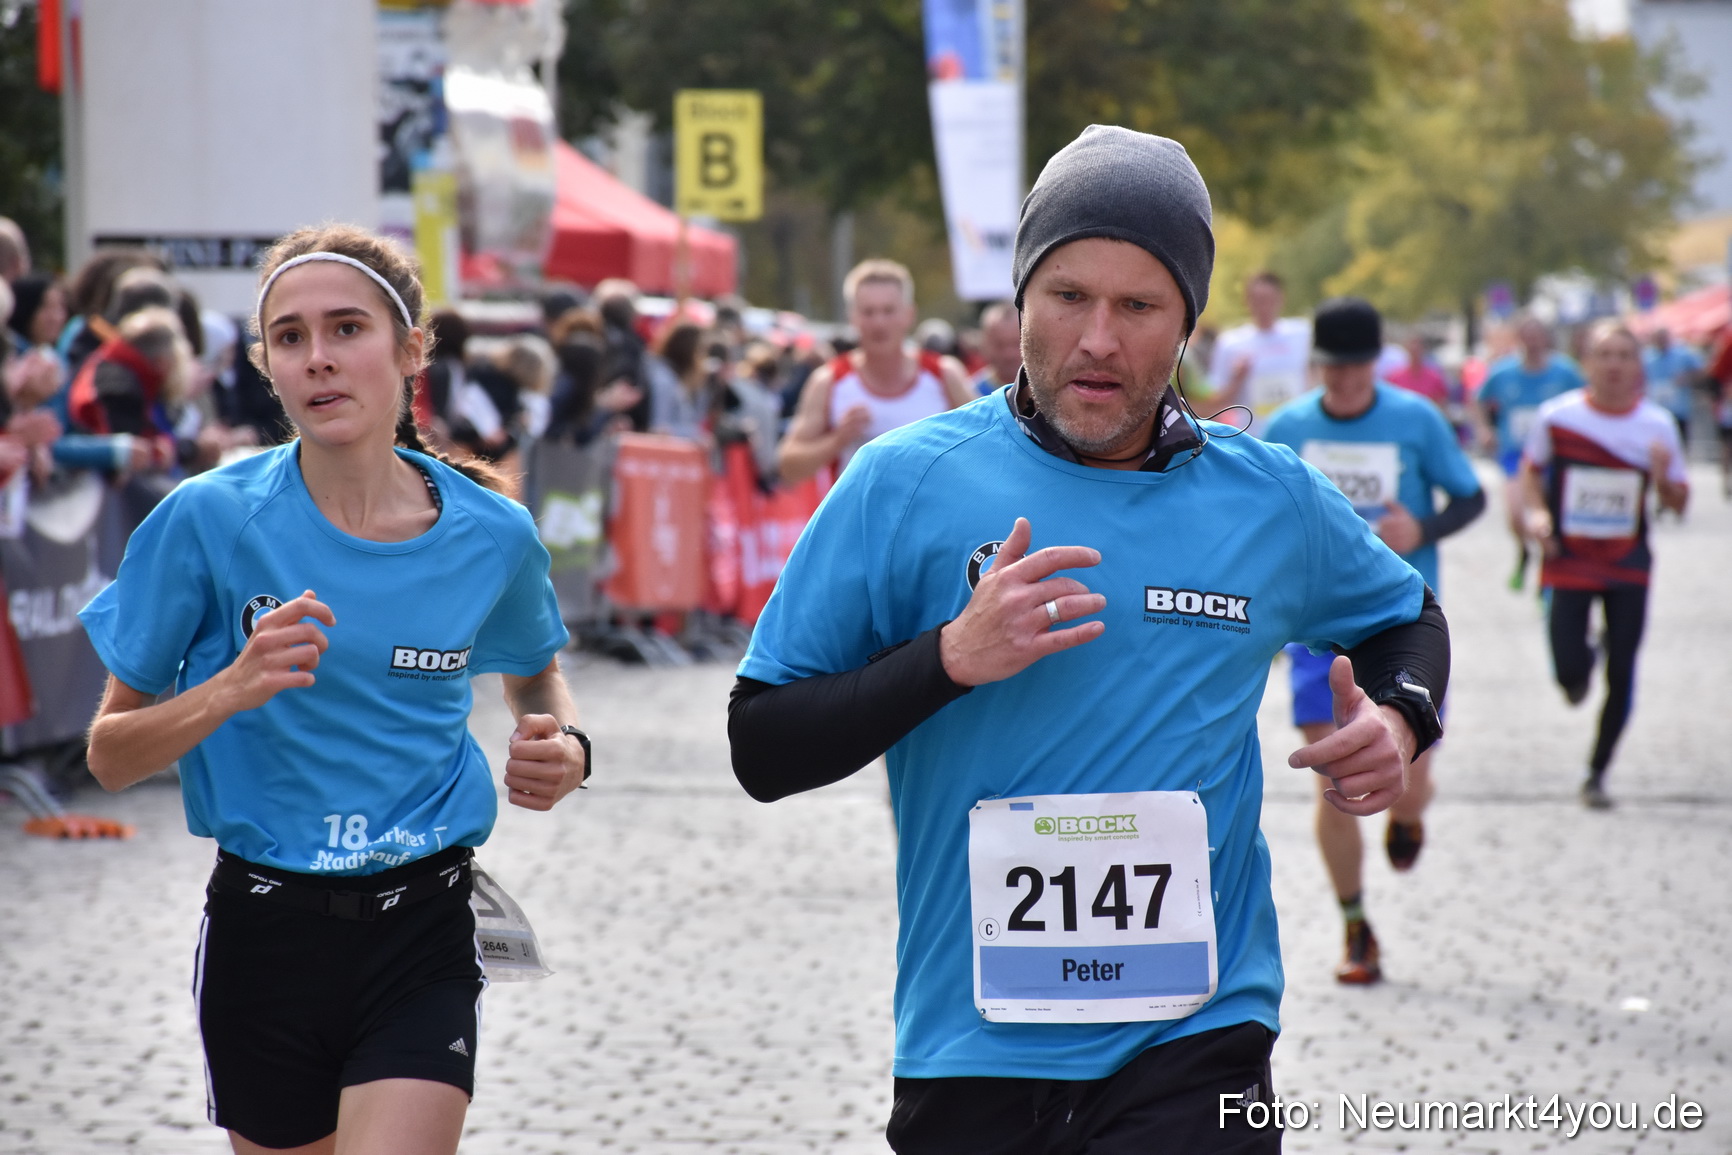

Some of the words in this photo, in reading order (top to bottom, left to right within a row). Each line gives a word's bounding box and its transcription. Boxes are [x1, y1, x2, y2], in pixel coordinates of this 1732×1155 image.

[700, 131, 740, 189] B
[1145, 586, 1251, 624] BOCK
[1143, 614, 1180, 625] inspired
[1182, 616, 1194, 628] by
[1196, 620, 1220, 630] smart
[1221, 623, 1251, 635] concepts
[391, 646, 472, 672] BOCK
[387, 670, 420, 680] inspired
[421, 672, 431, 682] by
[432, 673, 450, 682] smart
[1057, 814, 1138, 835] BOCK
[1057, 835, 1084, 843] inspired
[1084, 834, 1092, 843] by
[1094, 833, 1112, 841] smart
[1113, 832, 1140, 841] concepts
[1005, 863, 1173, 932] 2147
[985, 923, 994, 936] C
[482, 940, 509, 953] 2646
[1062, 958, 1125, 982] Peter
